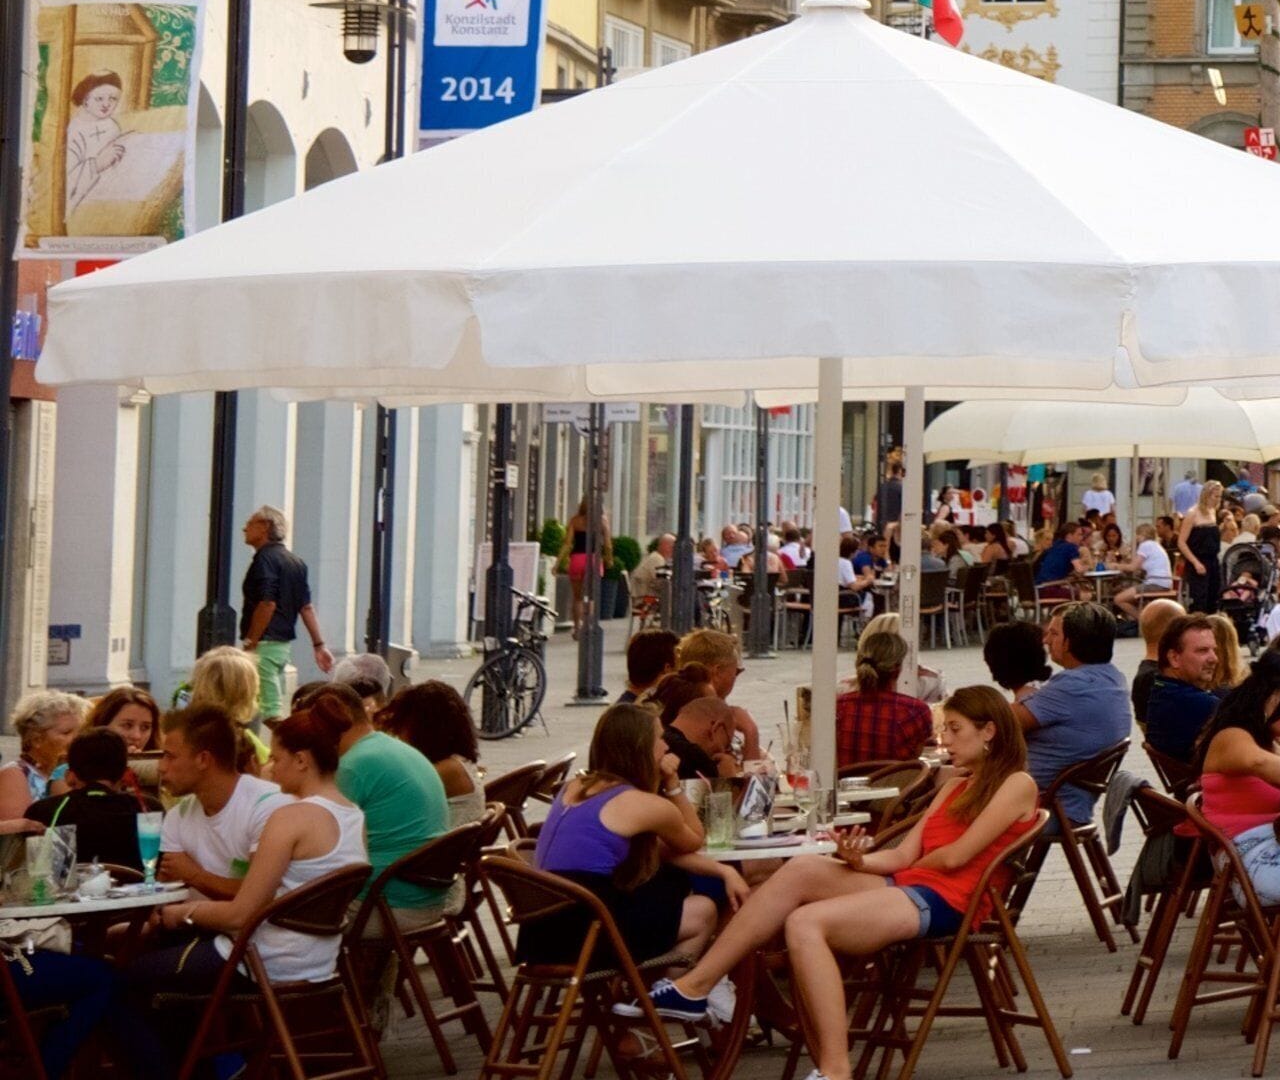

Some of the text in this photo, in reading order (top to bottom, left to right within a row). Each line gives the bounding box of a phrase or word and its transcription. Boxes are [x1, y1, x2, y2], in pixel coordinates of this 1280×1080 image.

[445, 13, 517, 26] Konzilstadt
[450, 24, 510, 36] Konstanz
[440, 76, 516, 104] 2014
